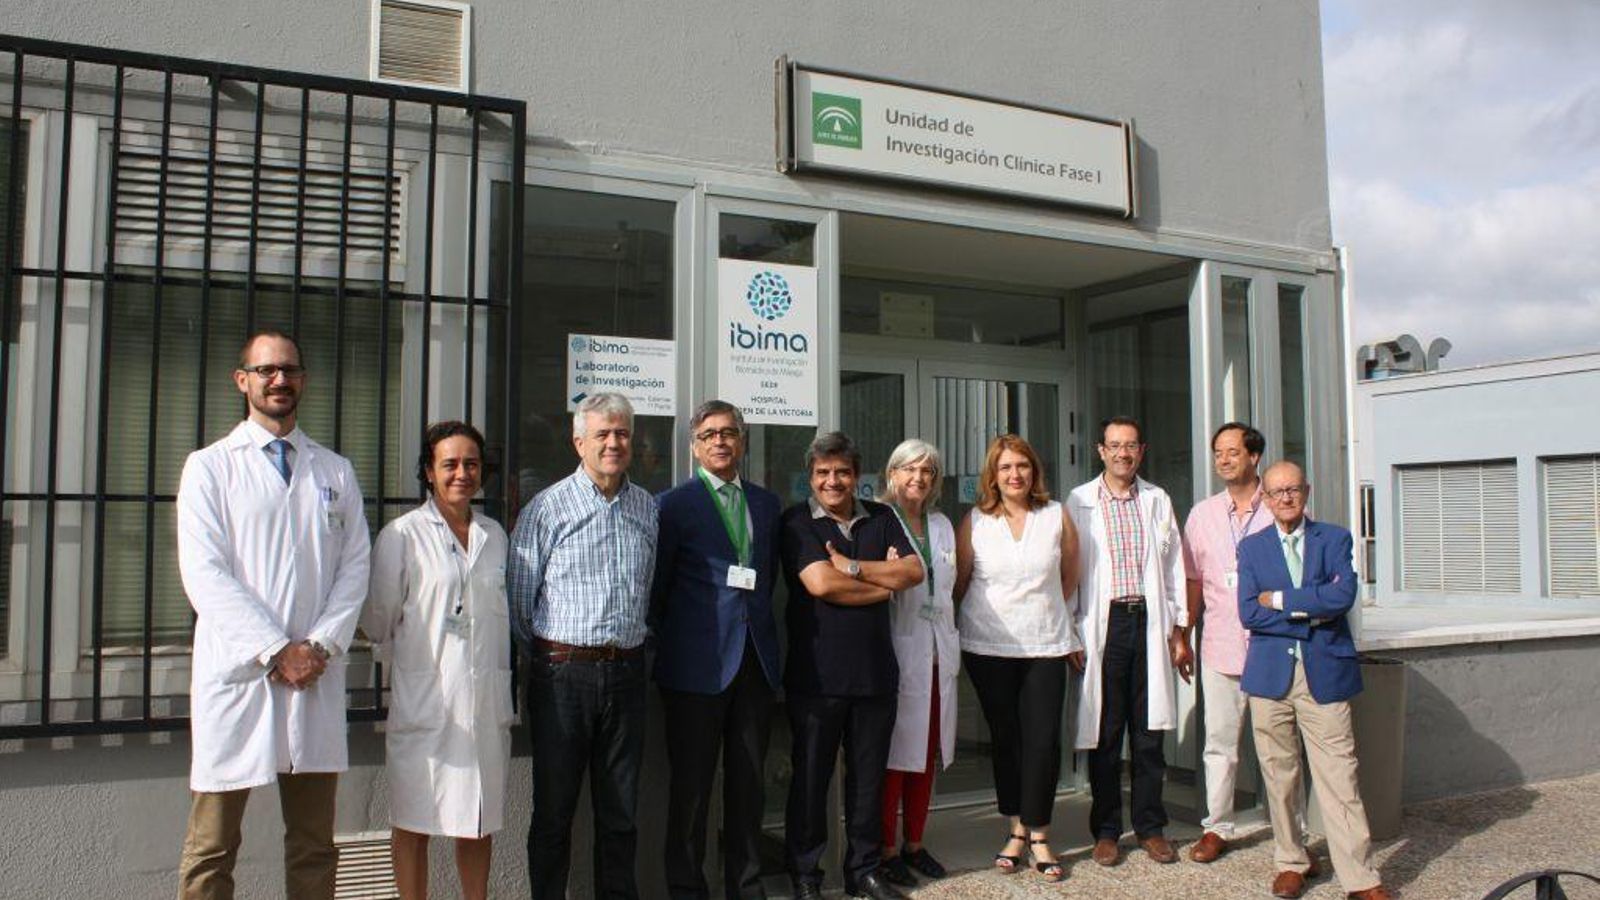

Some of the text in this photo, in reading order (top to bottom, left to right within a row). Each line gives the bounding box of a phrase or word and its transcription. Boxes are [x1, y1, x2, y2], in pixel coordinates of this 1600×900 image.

[885, 107, 974, 137] Unidad de
[885, 135, 1101, 184] Investigación Clínica Fase I
[730, 321, 808, 353] ibima
[589, 339, 629, 354] ibima
[575, 360, 640, 374] Laboratorio
[575, 375, 665, 390] de Investigación
[751, 396, 787, 405] HOSPITAL
[755, 407, 766, 415] DE
[779, 408, 814, 417] VICTORIA
